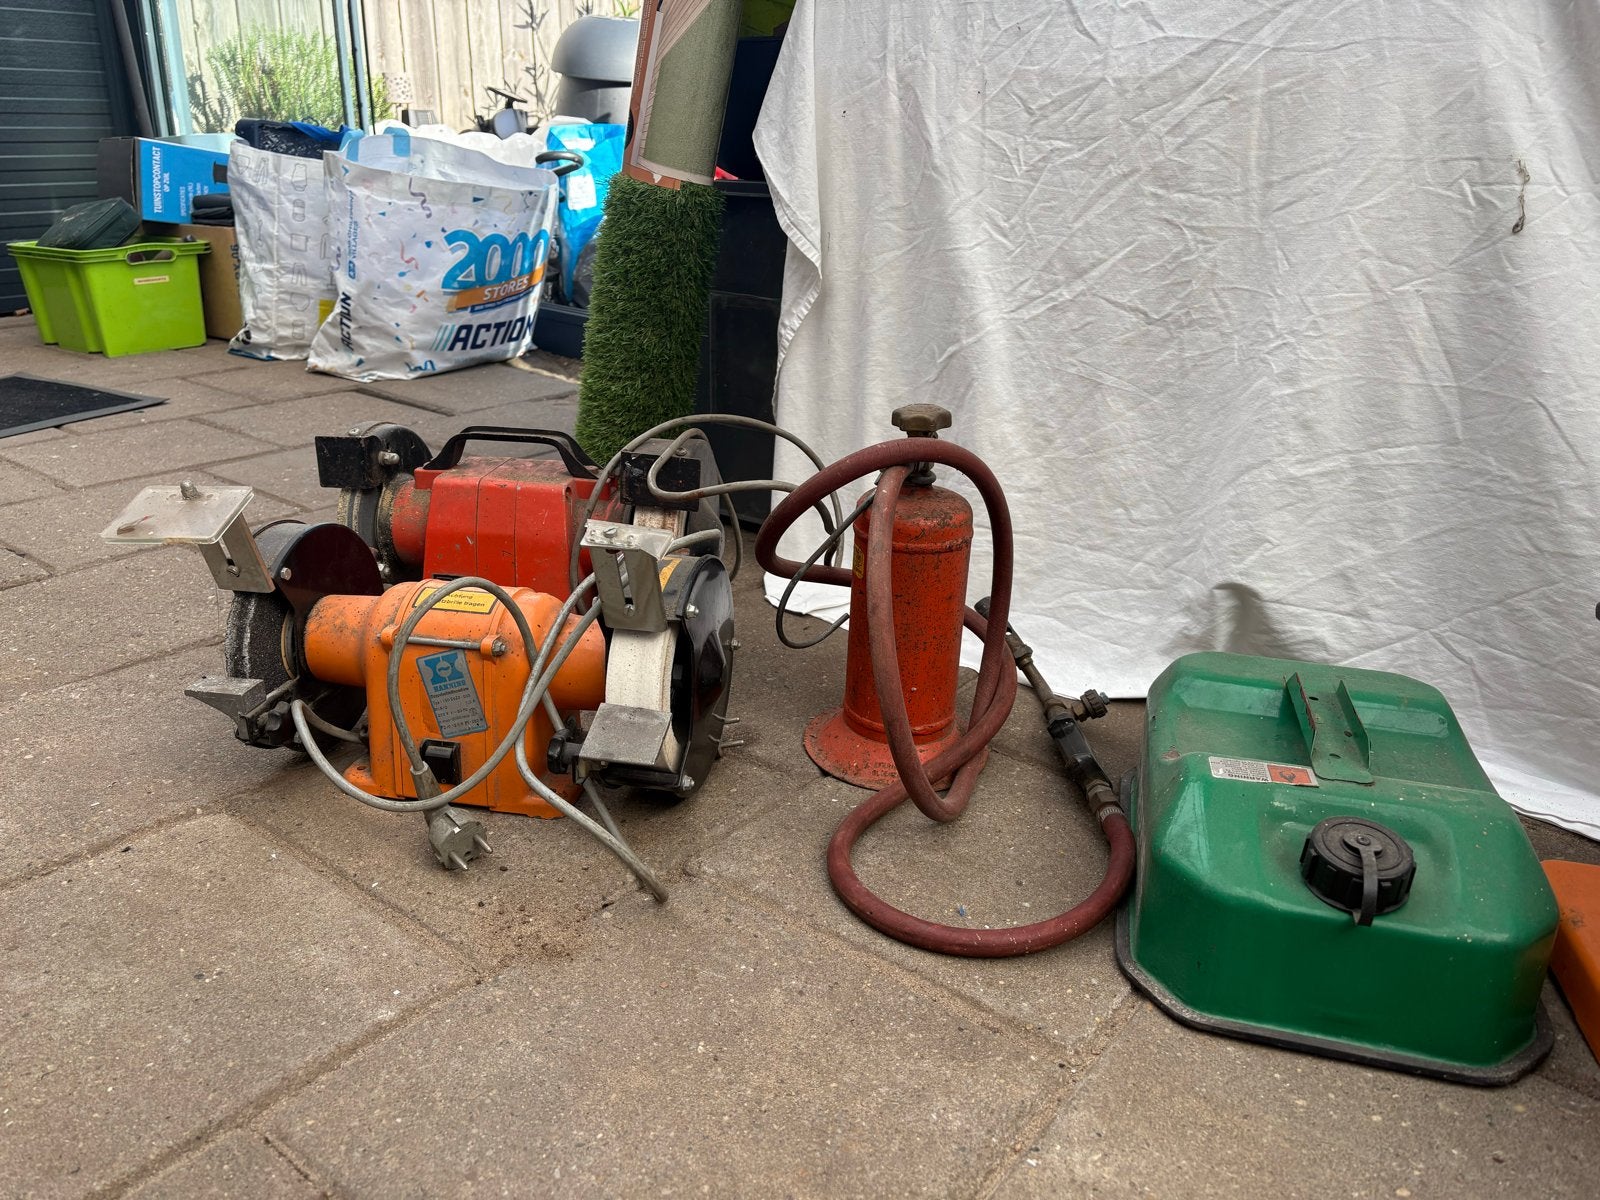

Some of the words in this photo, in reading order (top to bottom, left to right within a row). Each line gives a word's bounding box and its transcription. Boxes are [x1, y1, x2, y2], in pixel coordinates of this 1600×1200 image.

[152, 146, 162, 213] TUINSTOPCONTACT
[441, 229, 550, 294] 2000
[482, 275, 530, 302] STORES
[339, 291, 355, 352] ACTION
[447, 314, 537, 352] ACTION
[1227, 772, 1269, 782] WARNING
